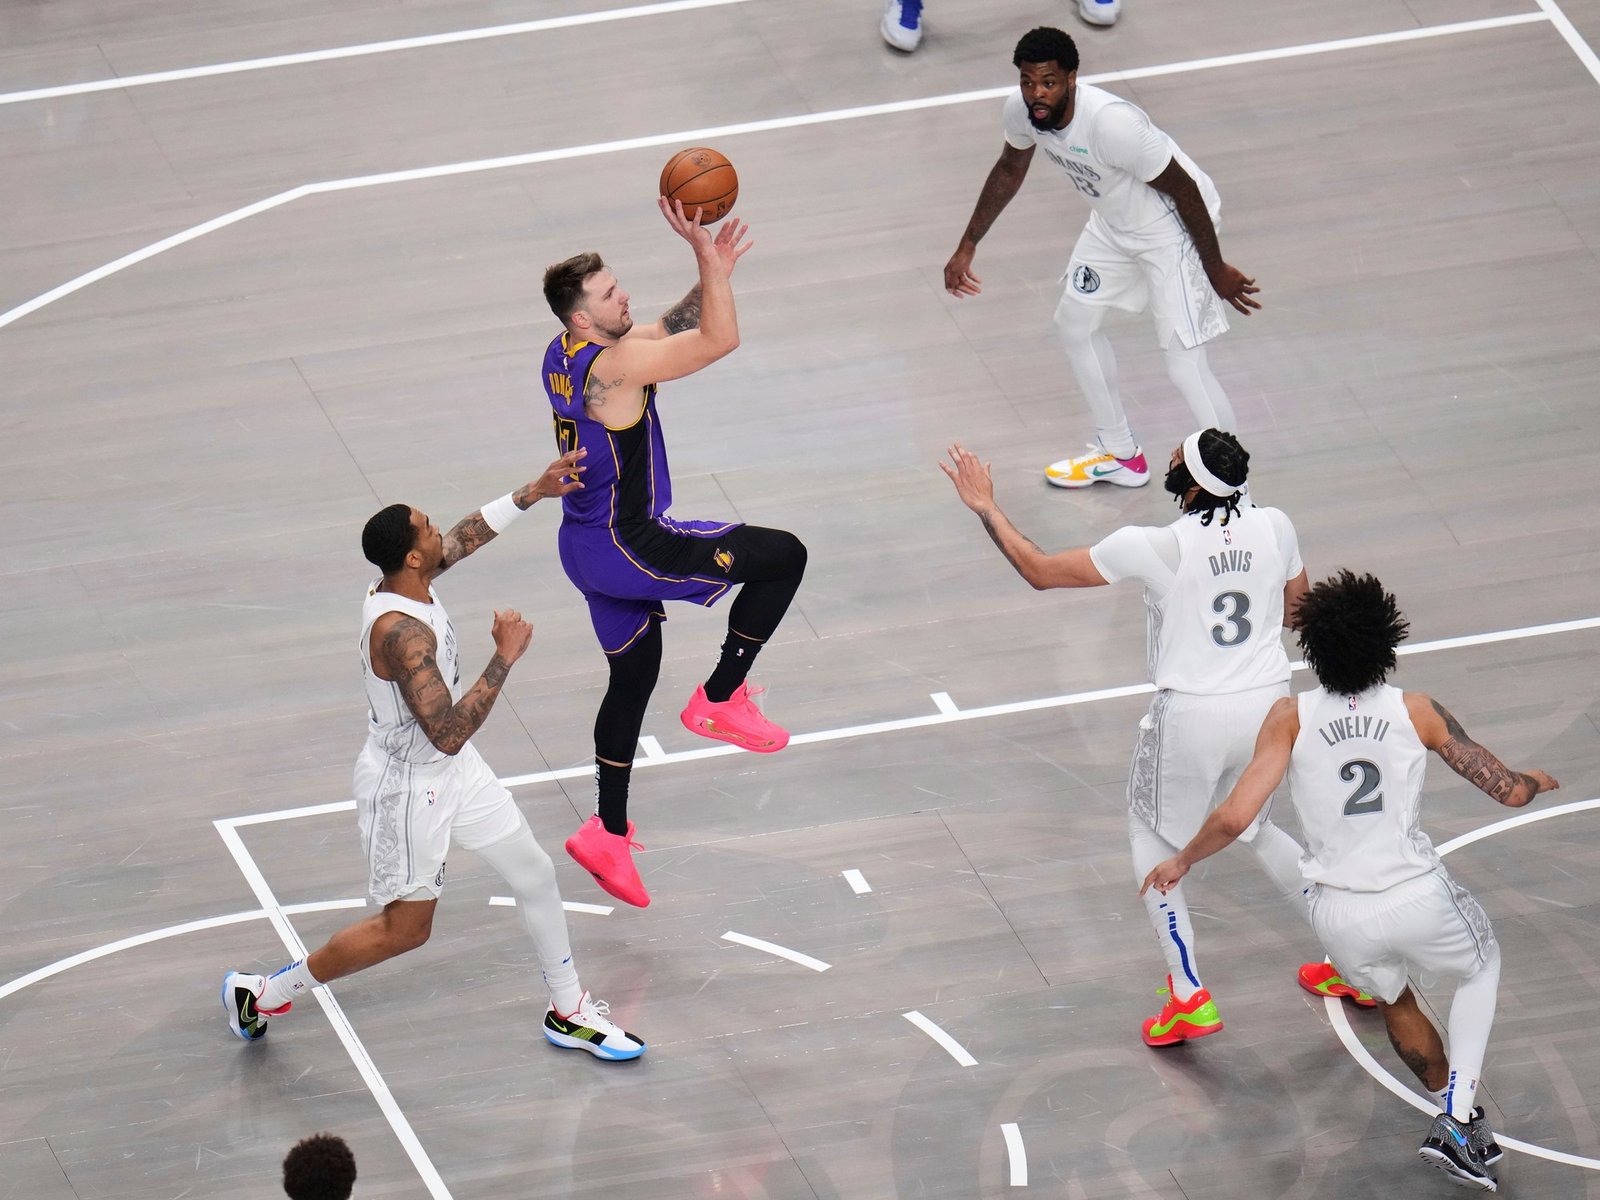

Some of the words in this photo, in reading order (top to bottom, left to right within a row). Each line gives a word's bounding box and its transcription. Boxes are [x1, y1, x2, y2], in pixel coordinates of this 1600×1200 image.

[1066, 172, 1100, 198] 13
[1208, 550, 1252, 577] DAVIS
[1211, 590, 1253, 648] 3
[1319, 716, 1372, 747] LIVELY
[1373, 719, 1390, 742] II
[1338, 758, 1385, 817] 2
